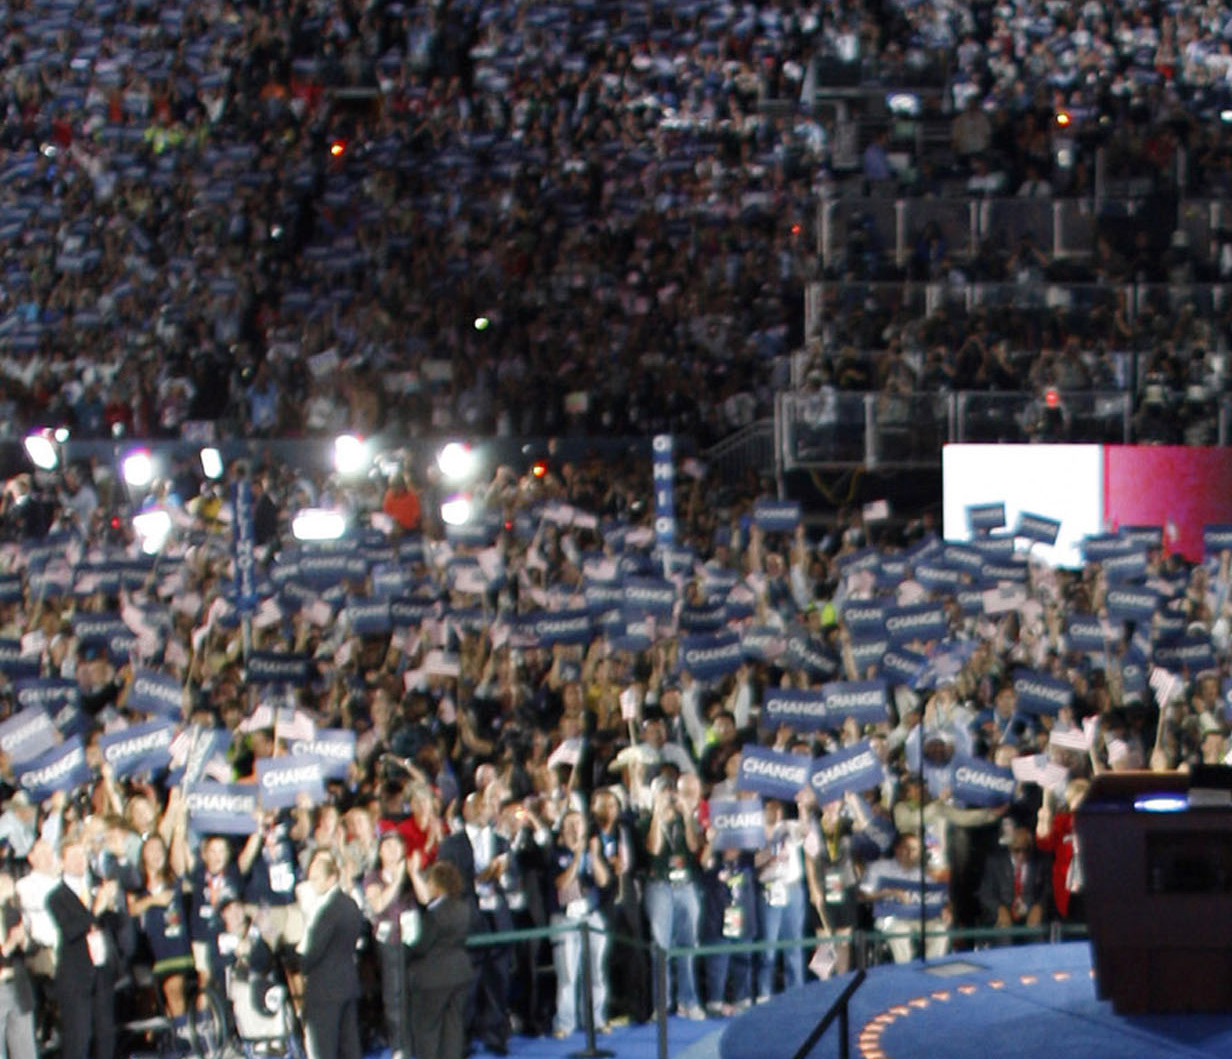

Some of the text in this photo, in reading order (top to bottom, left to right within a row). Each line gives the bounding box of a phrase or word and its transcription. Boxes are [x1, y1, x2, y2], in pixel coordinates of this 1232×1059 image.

[653, 435, 670, 533] OHIO
[755, 508, 799, 519] CHANGE
[845, 609, 882, 620] CHAN
[886, 610, 943, 630] CHANGE
[135, 679, 183, 705] CHANG
[827, 691, 882, 708] CHANGE
[1014, 678, 1072, 706] CHANGE
[105, 728, 169, 761] CHANGE
[292, 741, 353, 758] CHANGE
[21, 747, 84, 788] CHANGE
[262, 763, 320, 787] CHANGE
[742, 757, 807, 785] CHANGE
[811, 751, 874, 787] CHANGE
[955, 767, 1014, 795] CHANGE
[188, 795, 255, 811] CHANGE
